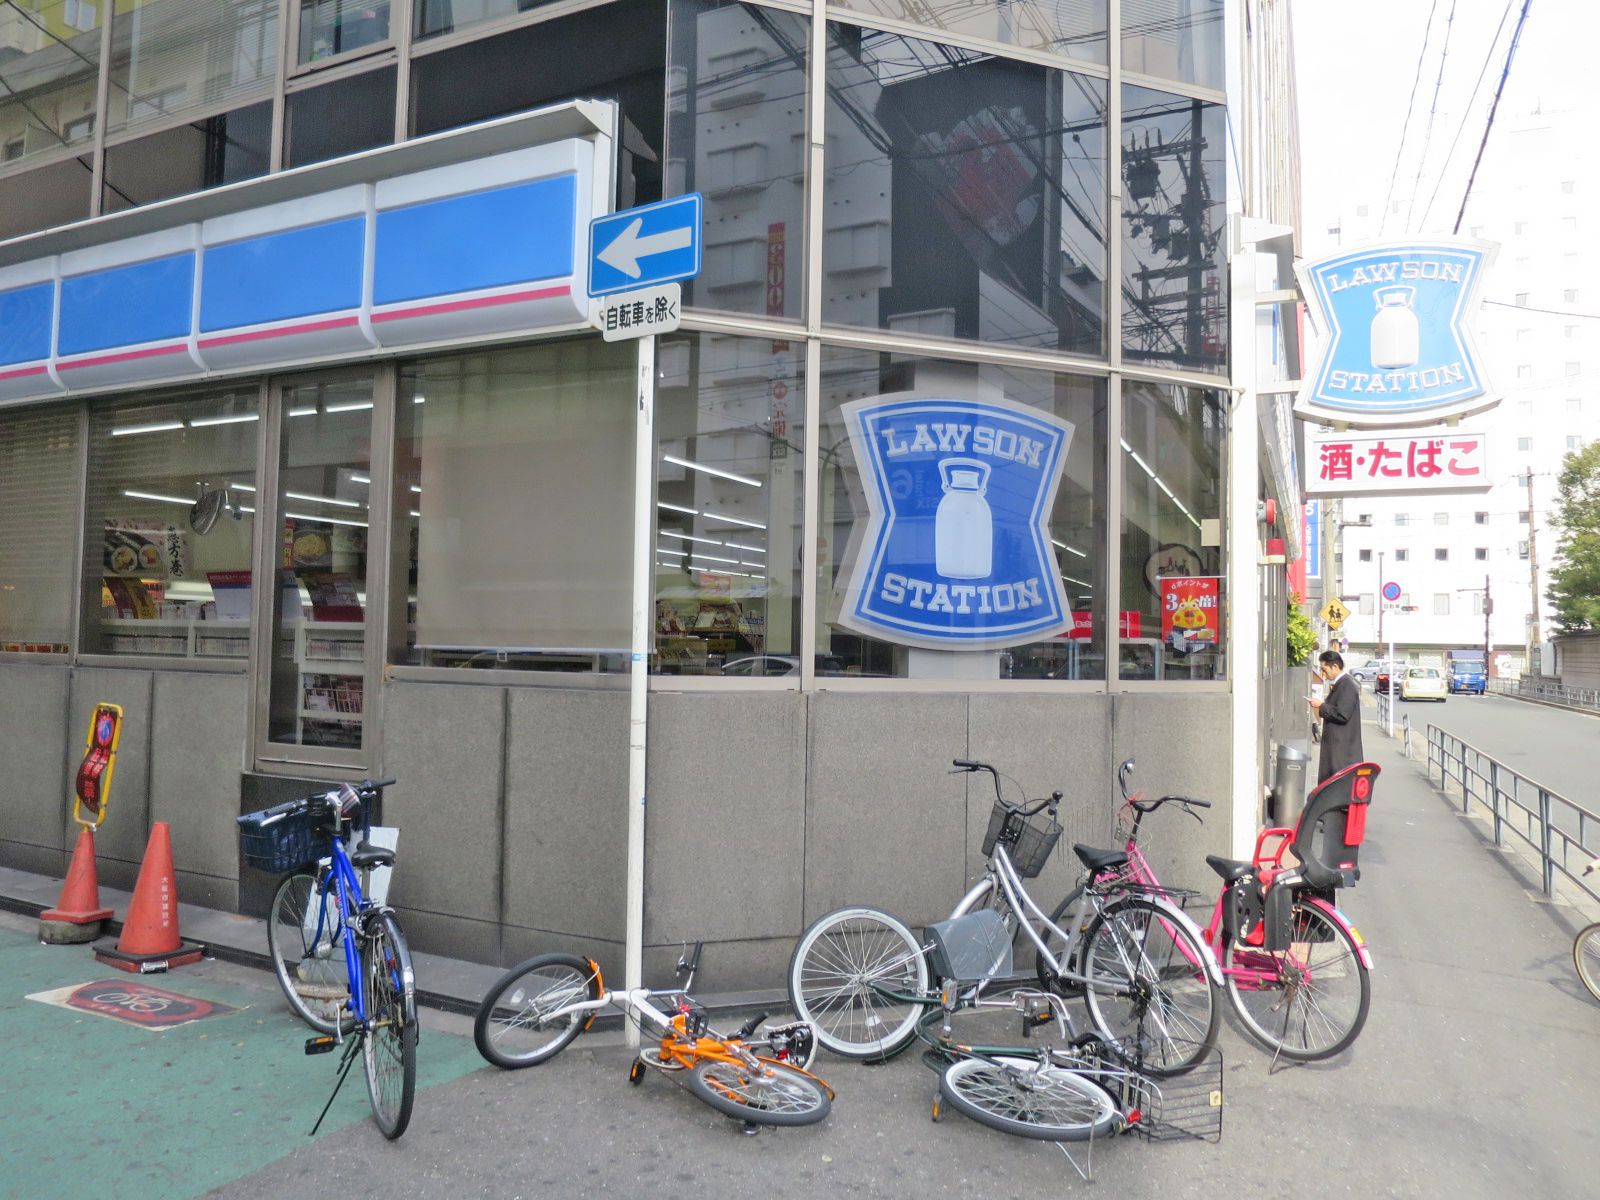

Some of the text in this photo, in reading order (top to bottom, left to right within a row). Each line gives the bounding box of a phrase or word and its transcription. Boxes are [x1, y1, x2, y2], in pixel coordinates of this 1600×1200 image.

[1327, 260, 1464, 294] LAWSON
[606, 295, 677, 331] 自転車を除く
[1328, 363, 1465, 394] STATION
[882, 423, 1045, 470] LAWSON
[1318, 439, 1481, 481] 酒・たばこ
[881, 571, 1044, 615] STATION
[1166, 593, 1178, 611] 3
